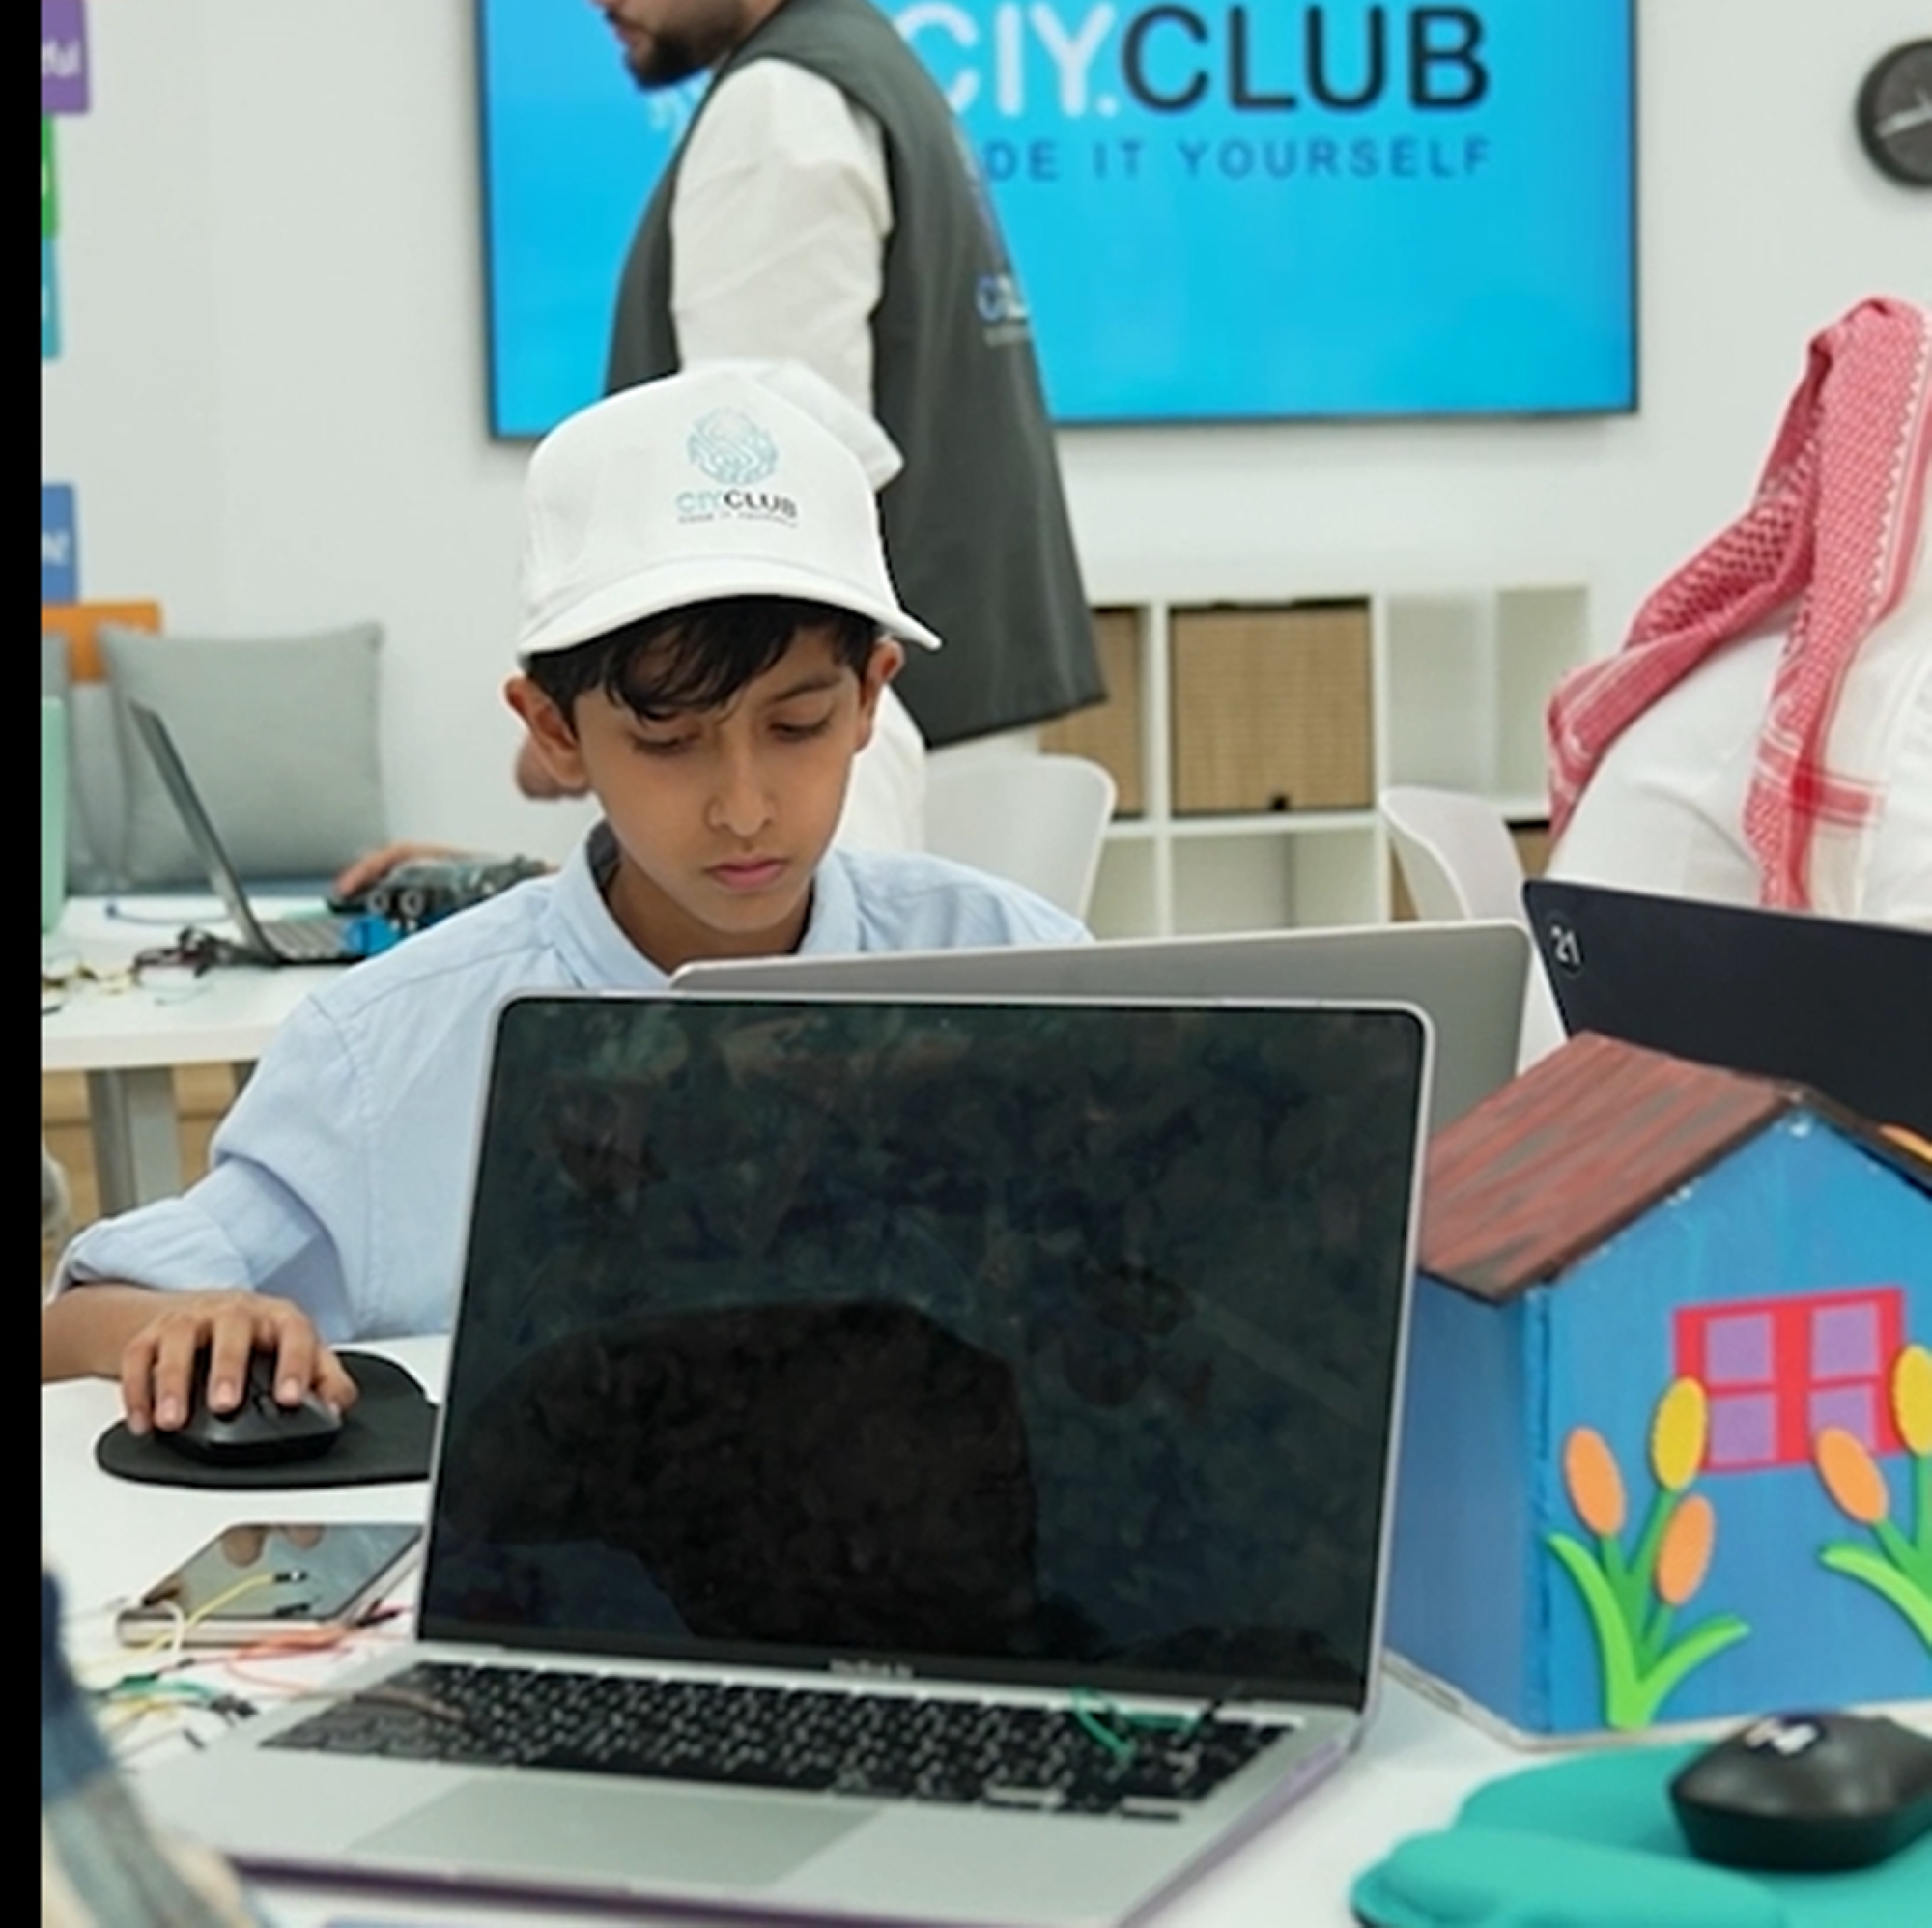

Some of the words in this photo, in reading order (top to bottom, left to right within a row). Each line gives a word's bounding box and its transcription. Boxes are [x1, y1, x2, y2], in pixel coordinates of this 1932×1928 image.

[983, 139, 1059, 181] DE
[1093, 140, 1142, 180] IT
[1176, 137, 1489, 181] YOURSELF
[1551, 926, 1579, 965] 21
